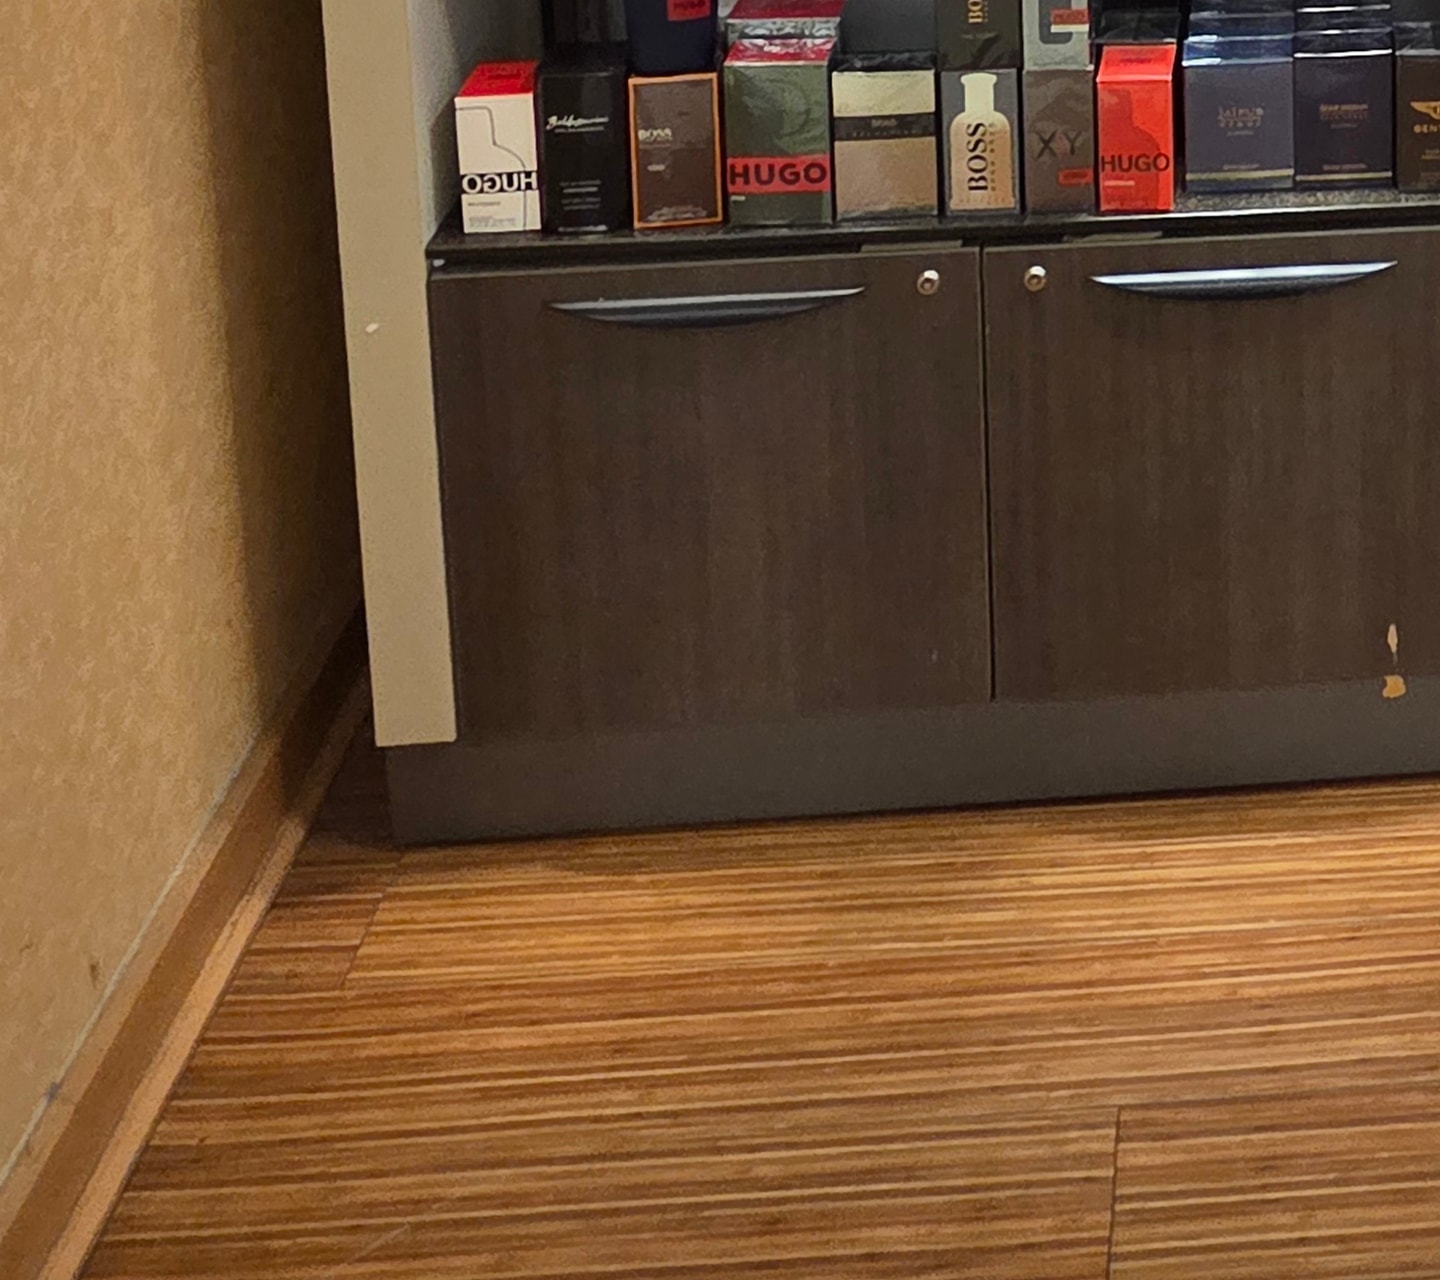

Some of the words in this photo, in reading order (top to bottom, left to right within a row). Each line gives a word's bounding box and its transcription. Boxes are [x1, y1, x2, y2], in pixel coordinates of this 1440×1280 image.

[966, 122, 989, 192] BOSS
[1101, 152, 1169, 174] HUGO
[729, 161, 828, 186] HUGO
